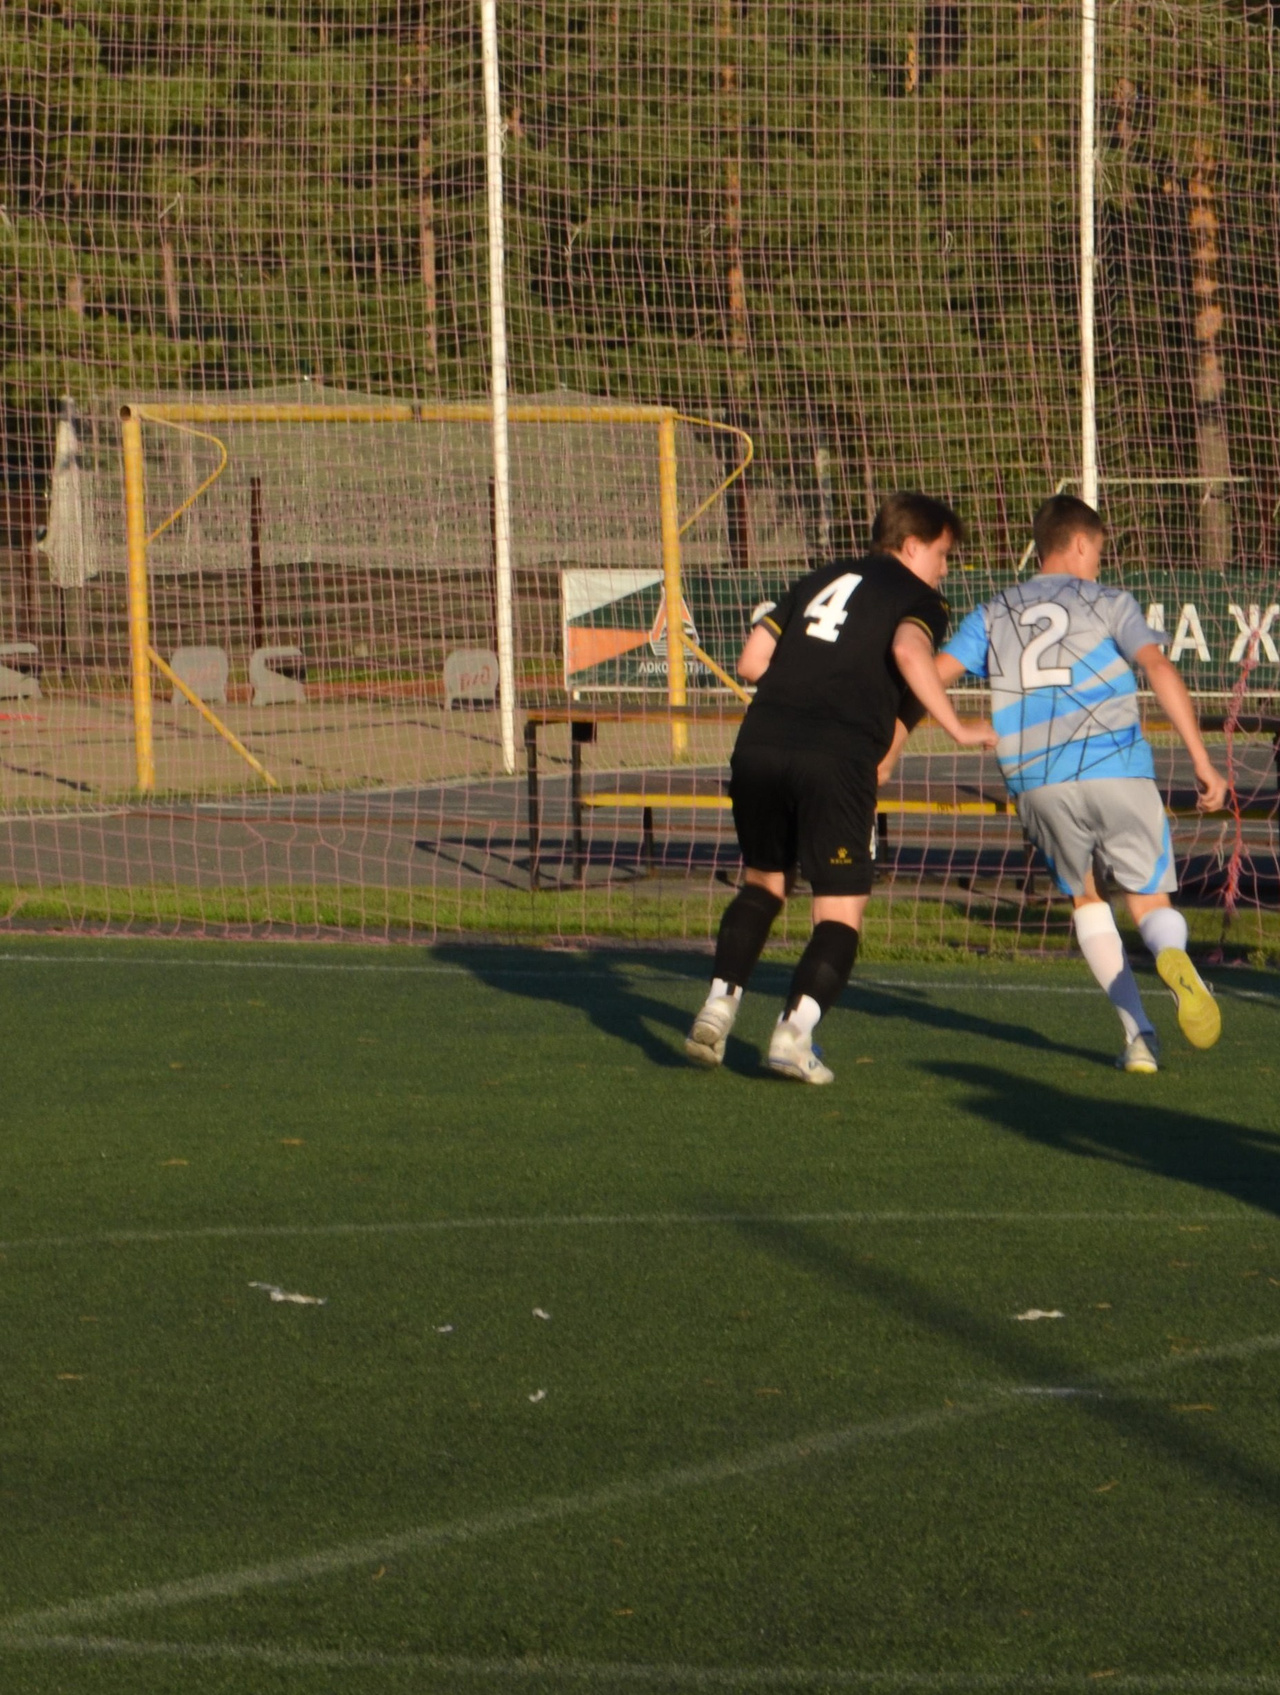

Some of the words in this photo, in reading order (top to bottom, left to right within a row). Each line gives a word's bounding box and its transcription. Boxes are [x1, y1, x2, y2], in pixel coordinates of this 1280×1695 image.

[803, 572, 863, 643] 4
[639, 661, 713, 675] ЛОКОТИВ
[1019, 601, 1073, 690] 2
